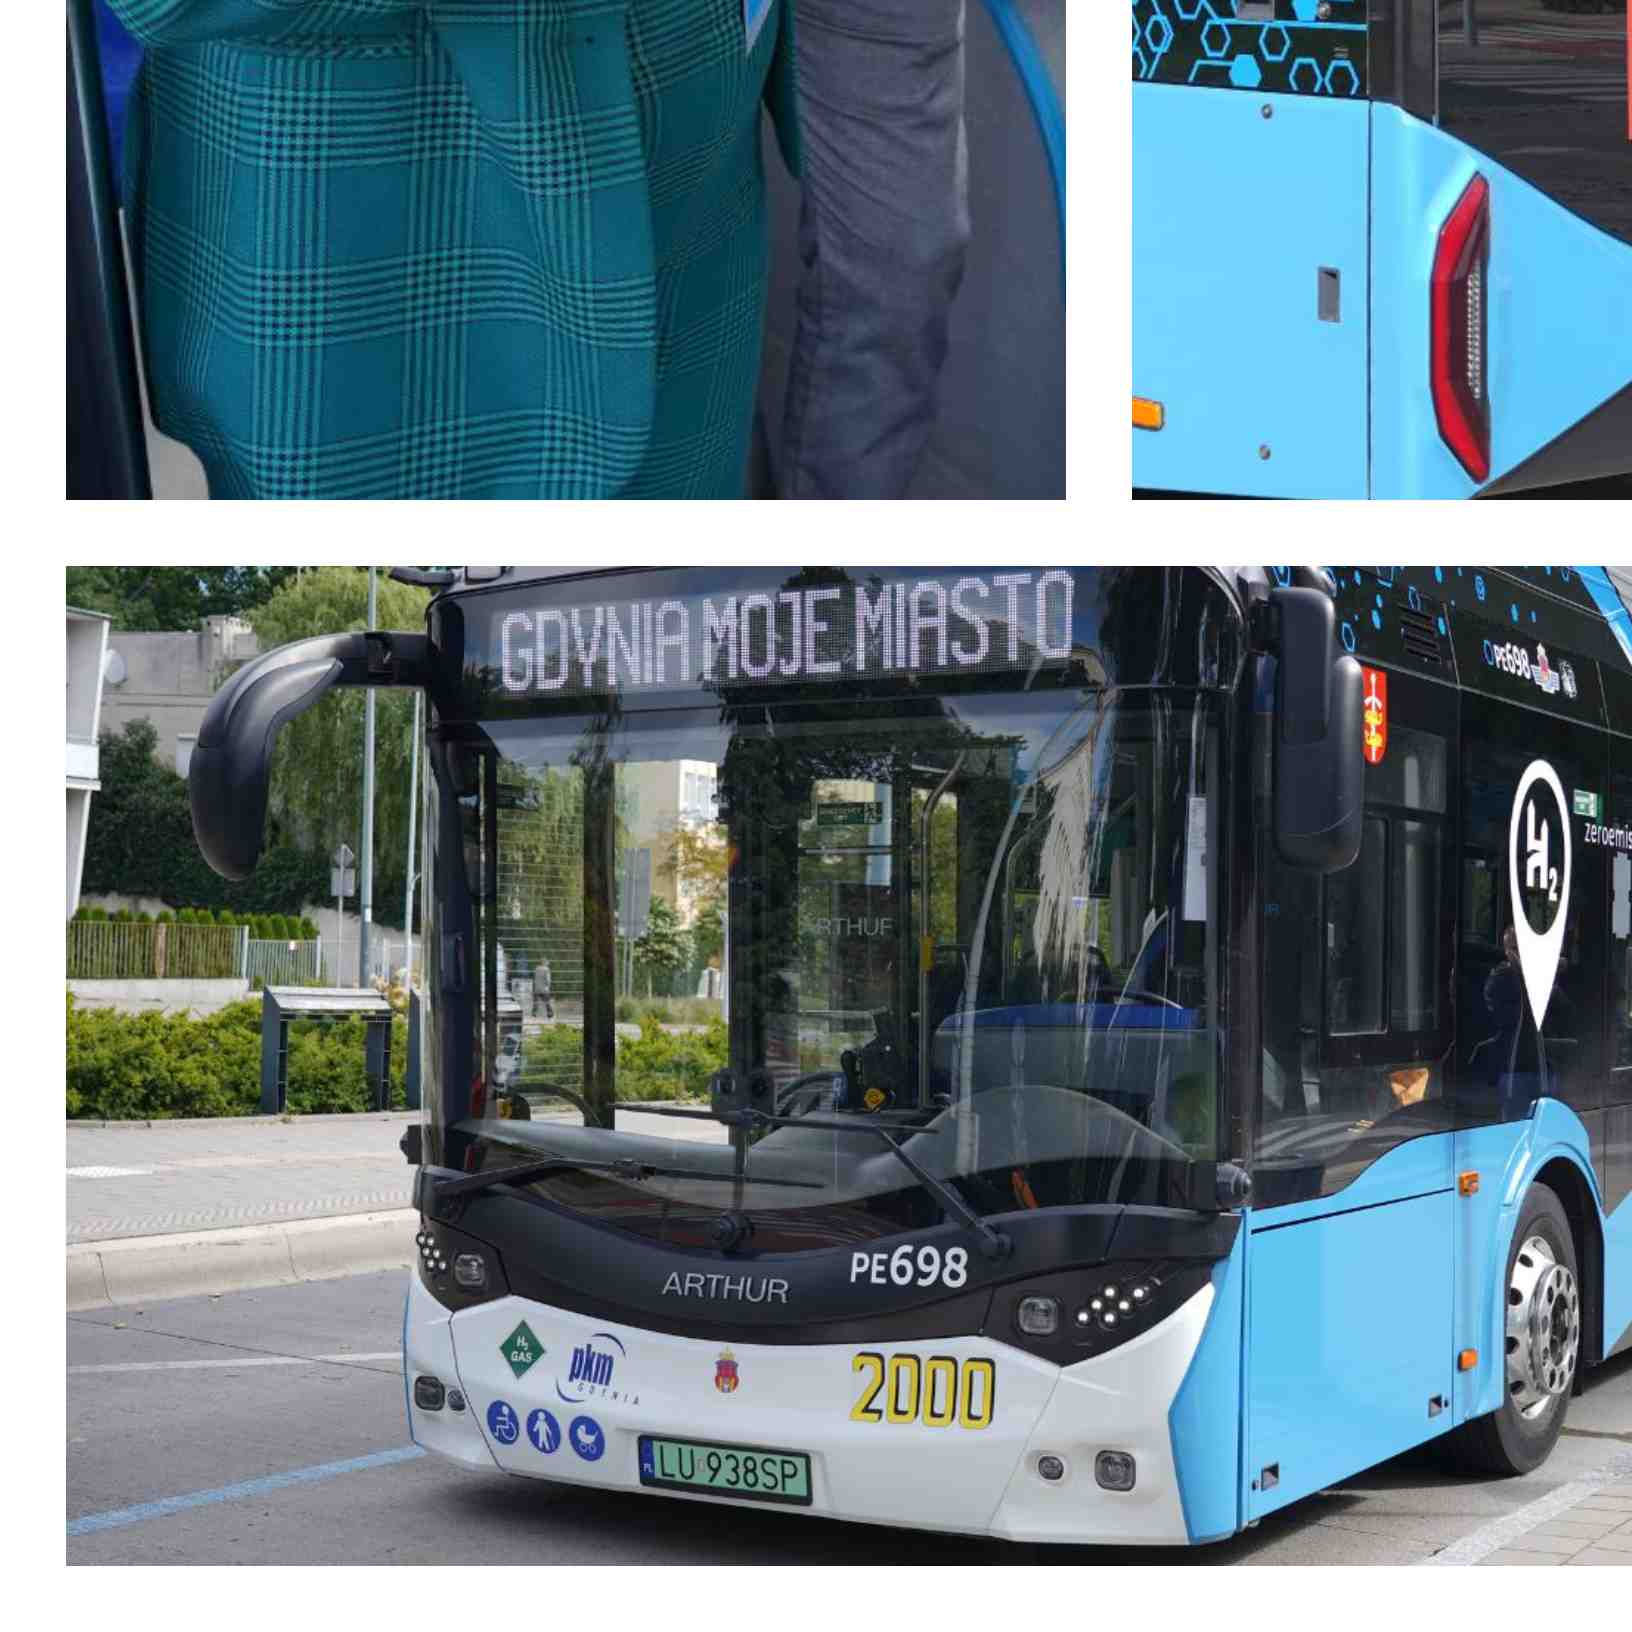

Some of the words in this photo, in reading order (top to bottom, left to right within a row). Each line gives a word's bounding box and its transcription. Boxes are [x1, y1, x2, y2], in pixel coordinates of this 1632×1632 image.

[500, 599, 691, 693] GDYNIA
[702, 587, 841, 681] MOJE
[854, 568, 1076, 673] MIASTO
[1493, 642, 1531, 681] PE698
[661, 1270, 789, 1304] ARTHUR
[849, 1244, 970, 1289] PE698
[510, 1350, 533, 1363] GAS
[567, 1343, 615, 1387] pkm
[576, 1381, 641, 1405] GDYNIA
[849, 1351, 997, 1430] 2000
[659, 1444, 696, 1481] LU
[705, 1450, 800, 1492] 938SP
